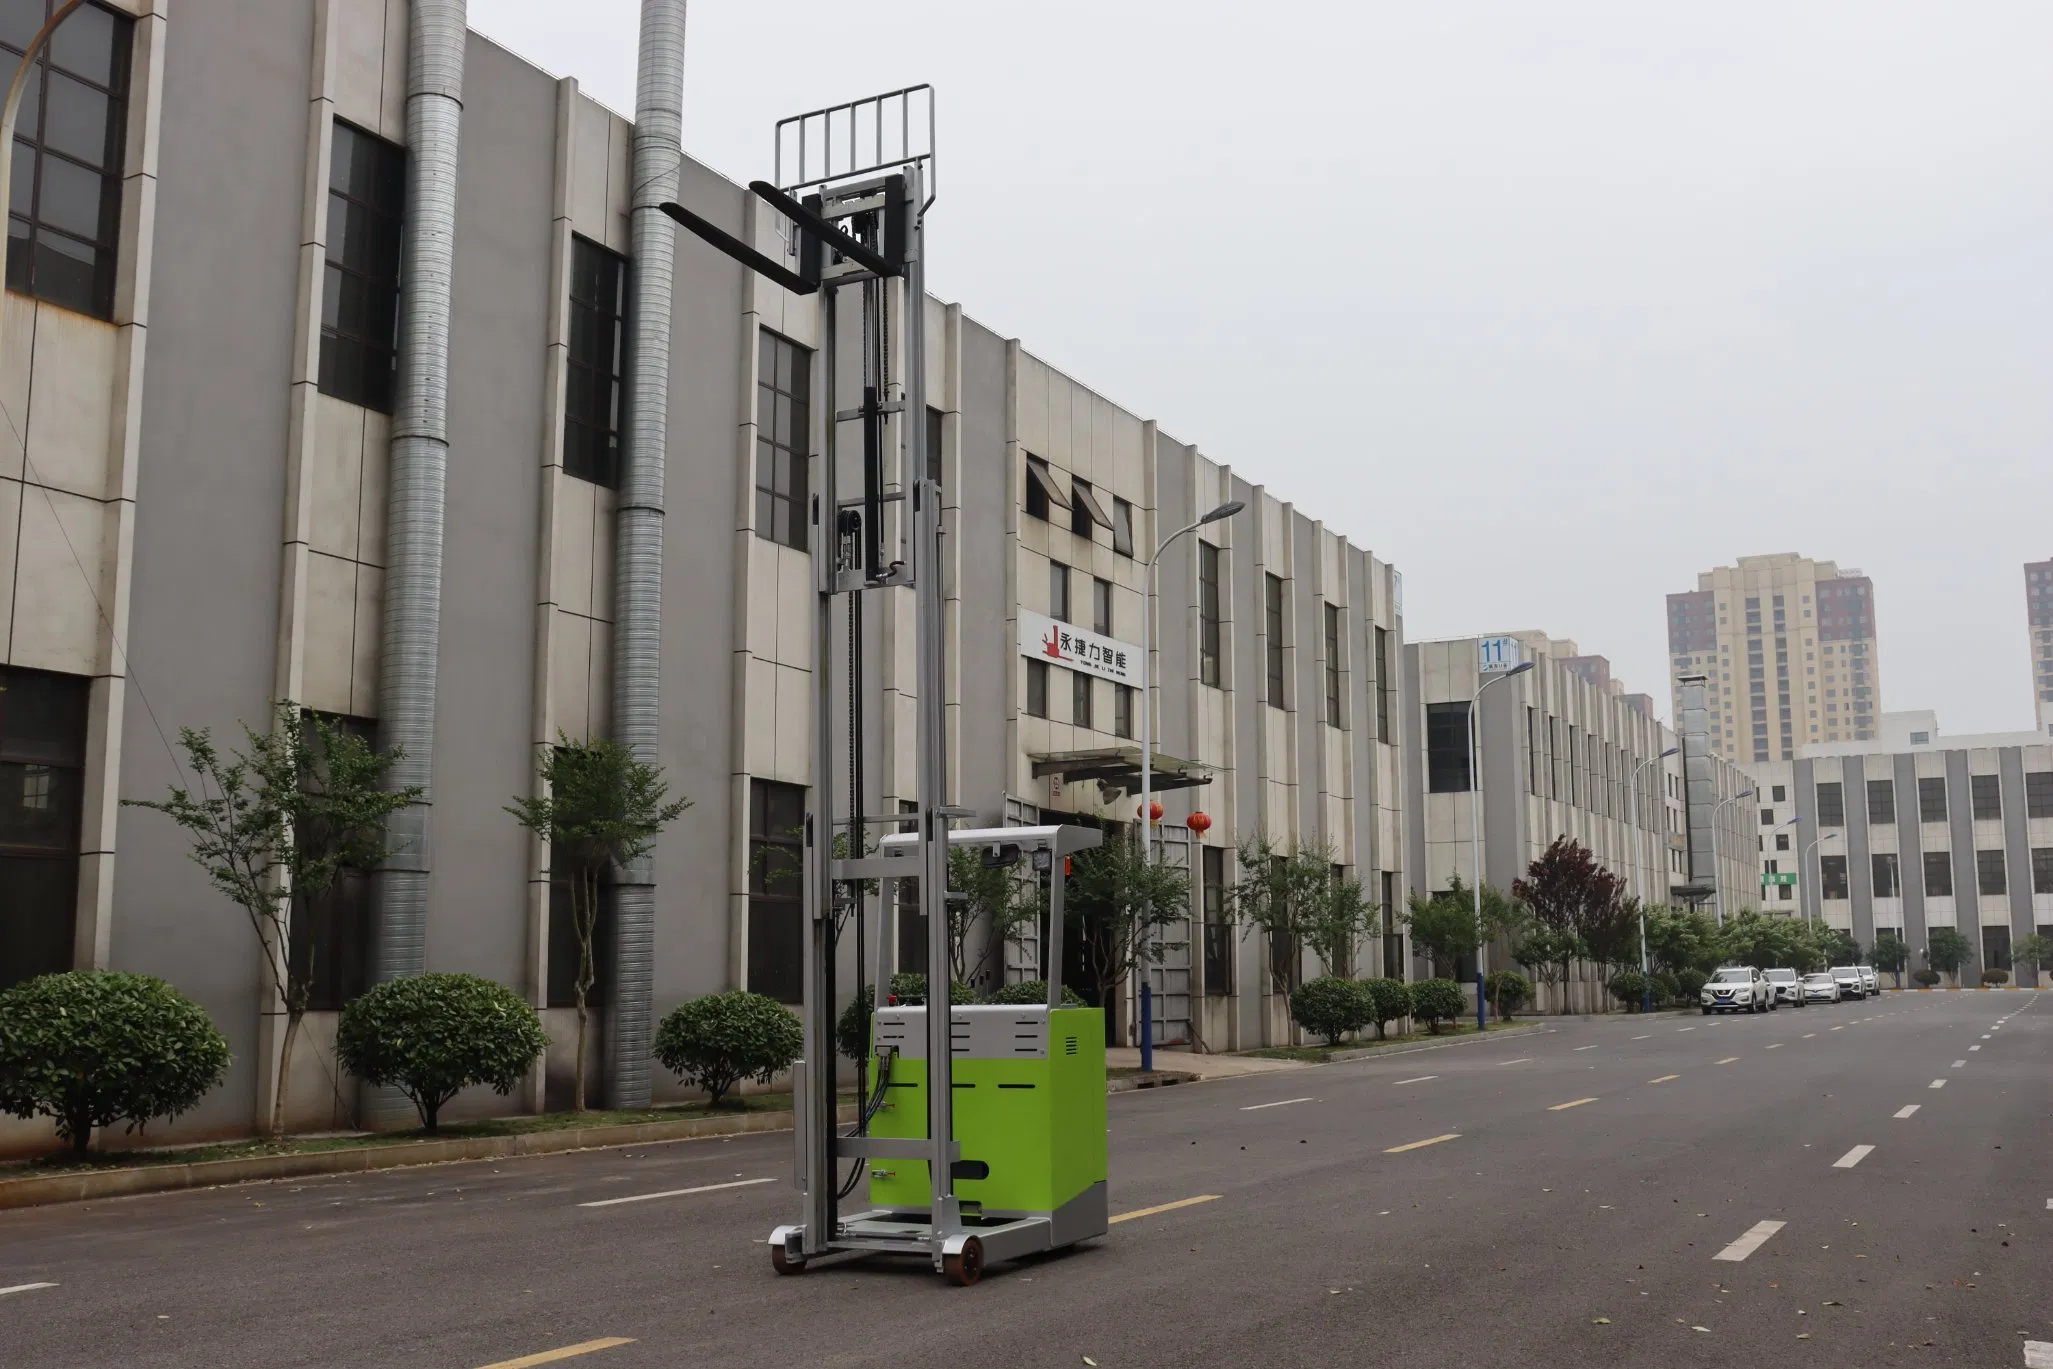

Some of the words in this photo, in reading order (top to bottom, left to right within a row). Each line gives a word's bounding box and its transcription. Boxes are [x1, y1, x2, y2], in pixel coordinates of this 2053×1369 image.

[1060, 632, 1127, 669] 永捷力智能
